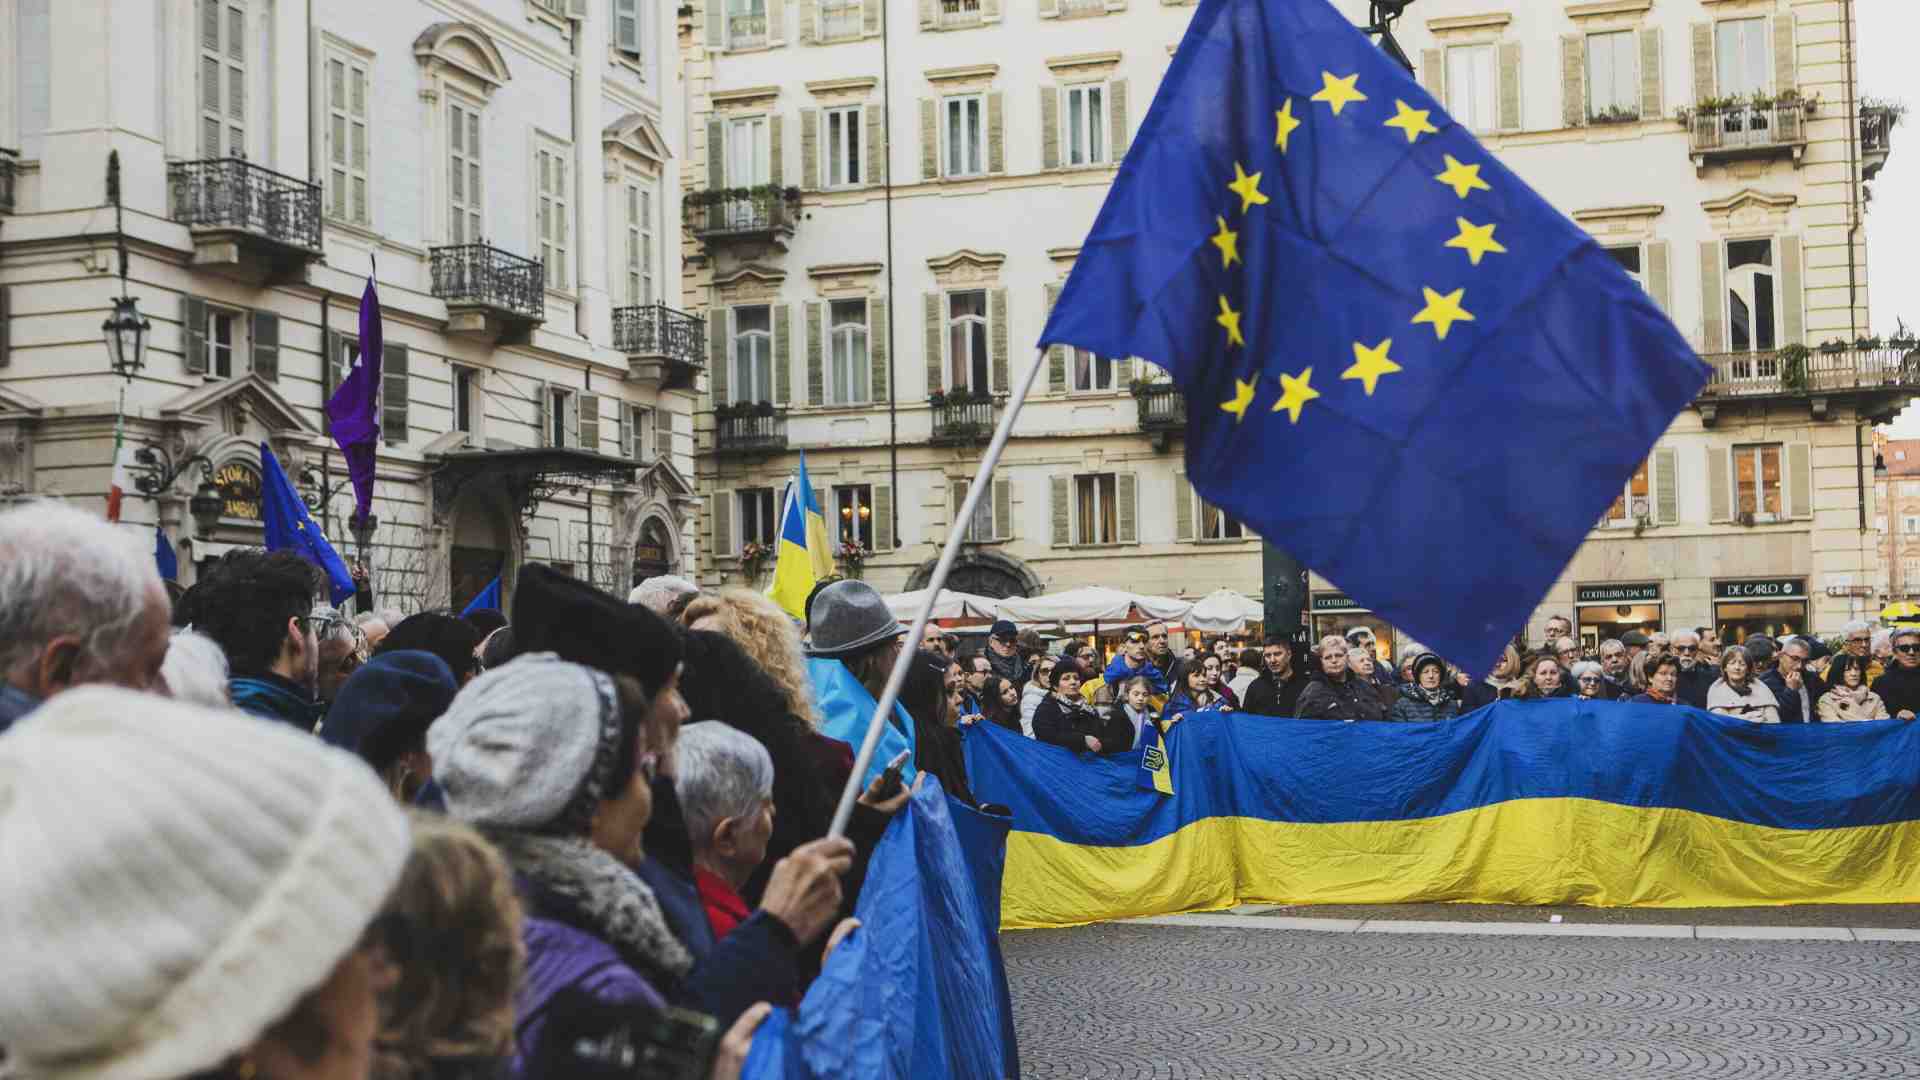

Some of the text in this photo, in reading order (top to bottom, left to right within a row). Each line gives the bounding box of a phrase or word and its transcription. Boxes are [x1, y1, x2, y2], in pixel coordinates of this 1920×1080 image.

[223, 499, 258, 519] AMBIO
[1727, 583, 1778, 596] DE CARLO
